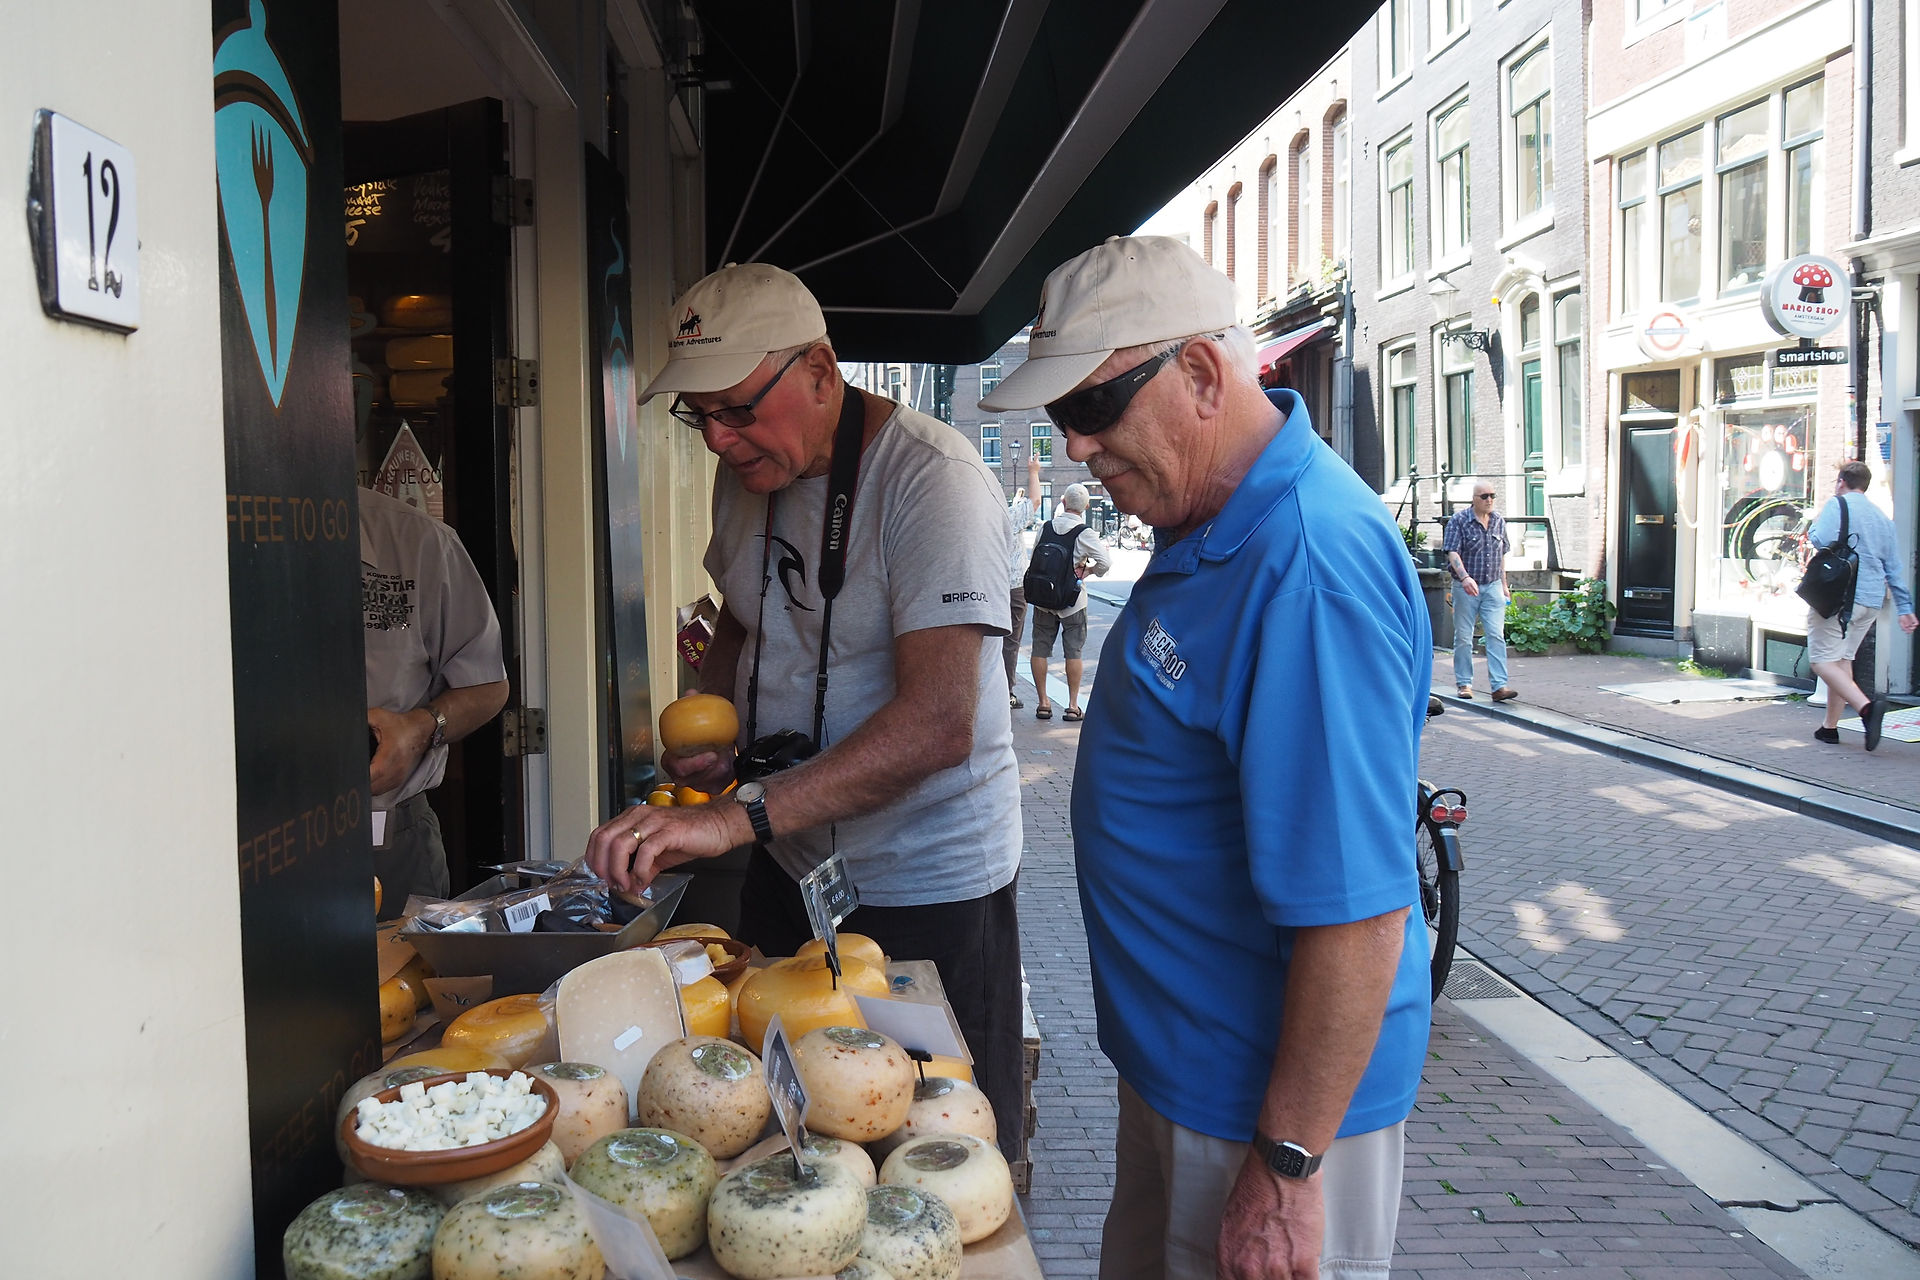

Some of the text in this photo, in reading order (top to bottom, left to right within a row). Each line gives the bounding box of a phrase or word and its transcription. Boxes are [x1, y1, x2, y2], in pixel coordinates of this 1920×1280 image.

[83, 151, 122, 299] 12
[1782, 303, 1840, 316] MARIO SHOP
[686, 336, 722, 346] Adventures
[1779, 350, 1845, 362] smartshop
[288, 497, 317, 541] TO
[321, 498, 349, 541] GO
[829, 493, 848, 550] Canon
[301, 804, 328, 856] TO
[335, 788, 360, 837] GO
